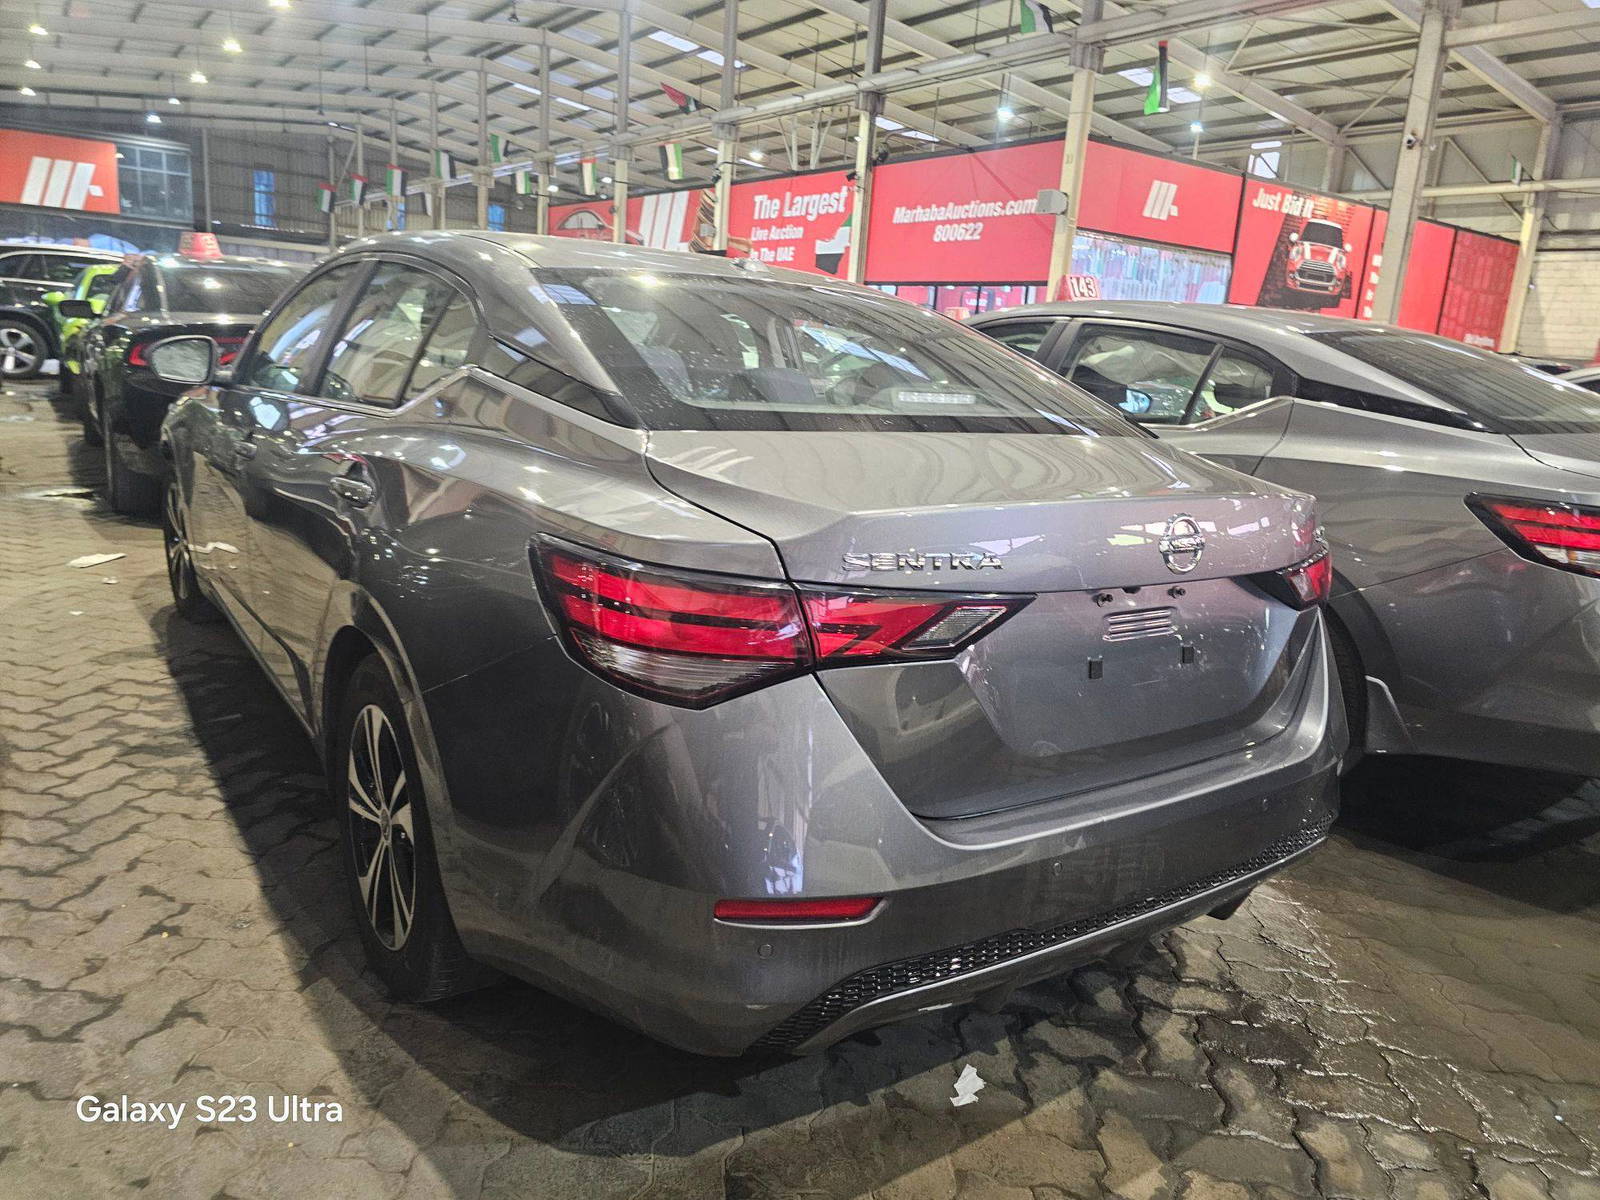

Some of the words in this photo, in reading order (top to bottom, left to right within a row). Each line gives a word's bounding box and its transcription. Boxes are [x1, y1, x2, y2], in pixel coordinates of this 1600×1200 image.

[753, 194, 780, 220] The
[782, 186, 848, 221] Largest
[892, 199, 1038, 224] MarhabaAuctions.com
[1252, 187, 1281, 211] Just
[1281, 193, 1303, 217] Bid
[1302, 198, 1315, 219] It
[751, 226, 769, 241] Live
[769, 224, 804, 240] Auction
[933, 222, 984, 242] 800622
[760, 247, 775, 262] The
[776, 246, 795, 261] UAE
[1070, 276, 1097, 299] 143
[842, 551, 1004, 572] SENTRA
